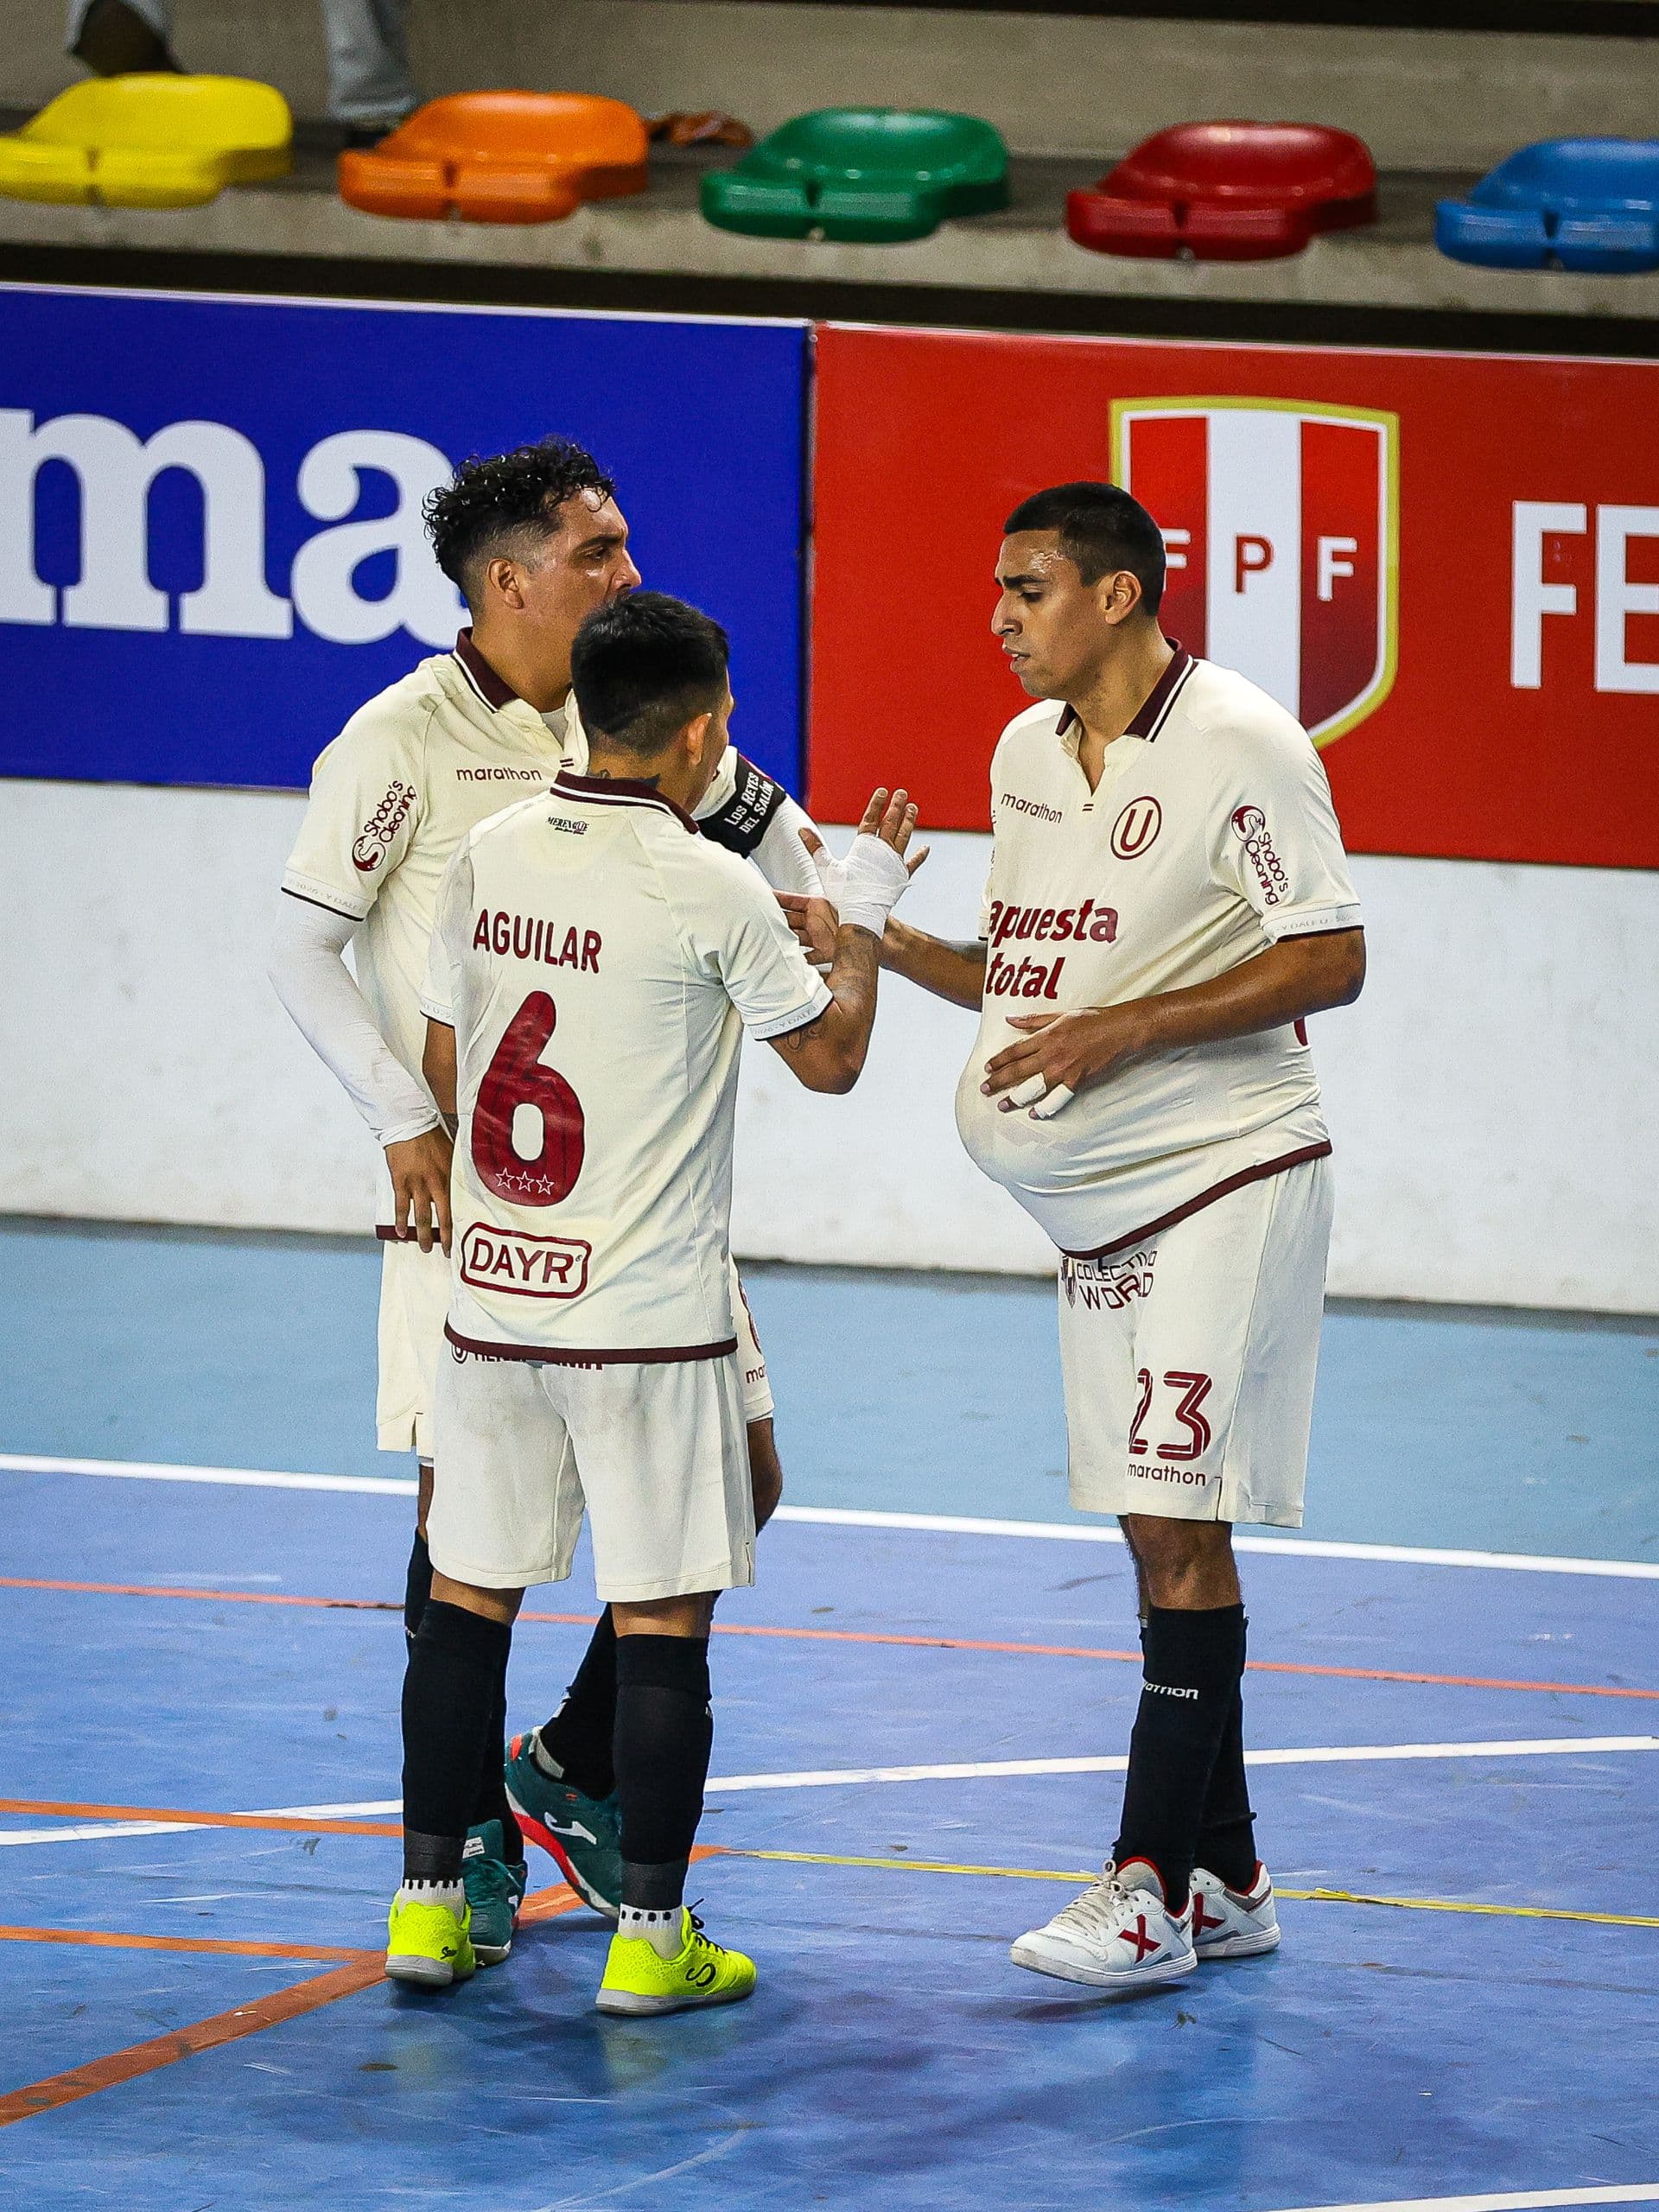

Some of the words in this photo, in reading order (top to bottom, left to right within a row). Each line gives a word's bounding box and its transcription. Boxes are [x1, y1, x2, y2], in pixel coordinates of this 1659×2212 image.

[1510, 499, 1659, 695] FE
[456, 766, 543, 781] marathon
[724, 804, 747, 826] LOS
[741, 772, 760, 806] REYES
[1001, 792, 1064, 823] marathon
[739, 817, 760, 835] DEL
[1119, 808, 1154, 853] U
[473, 908, 602, 974] AGUILAR
[989, 899, 1119, 949] apuesta
[985, 952, 1066, 1000] total
[471, 990, 587, 1209] 6
[1128, 1368, 1213, 1462] 23
[1127, 1463, 1207, 1487] marathon
